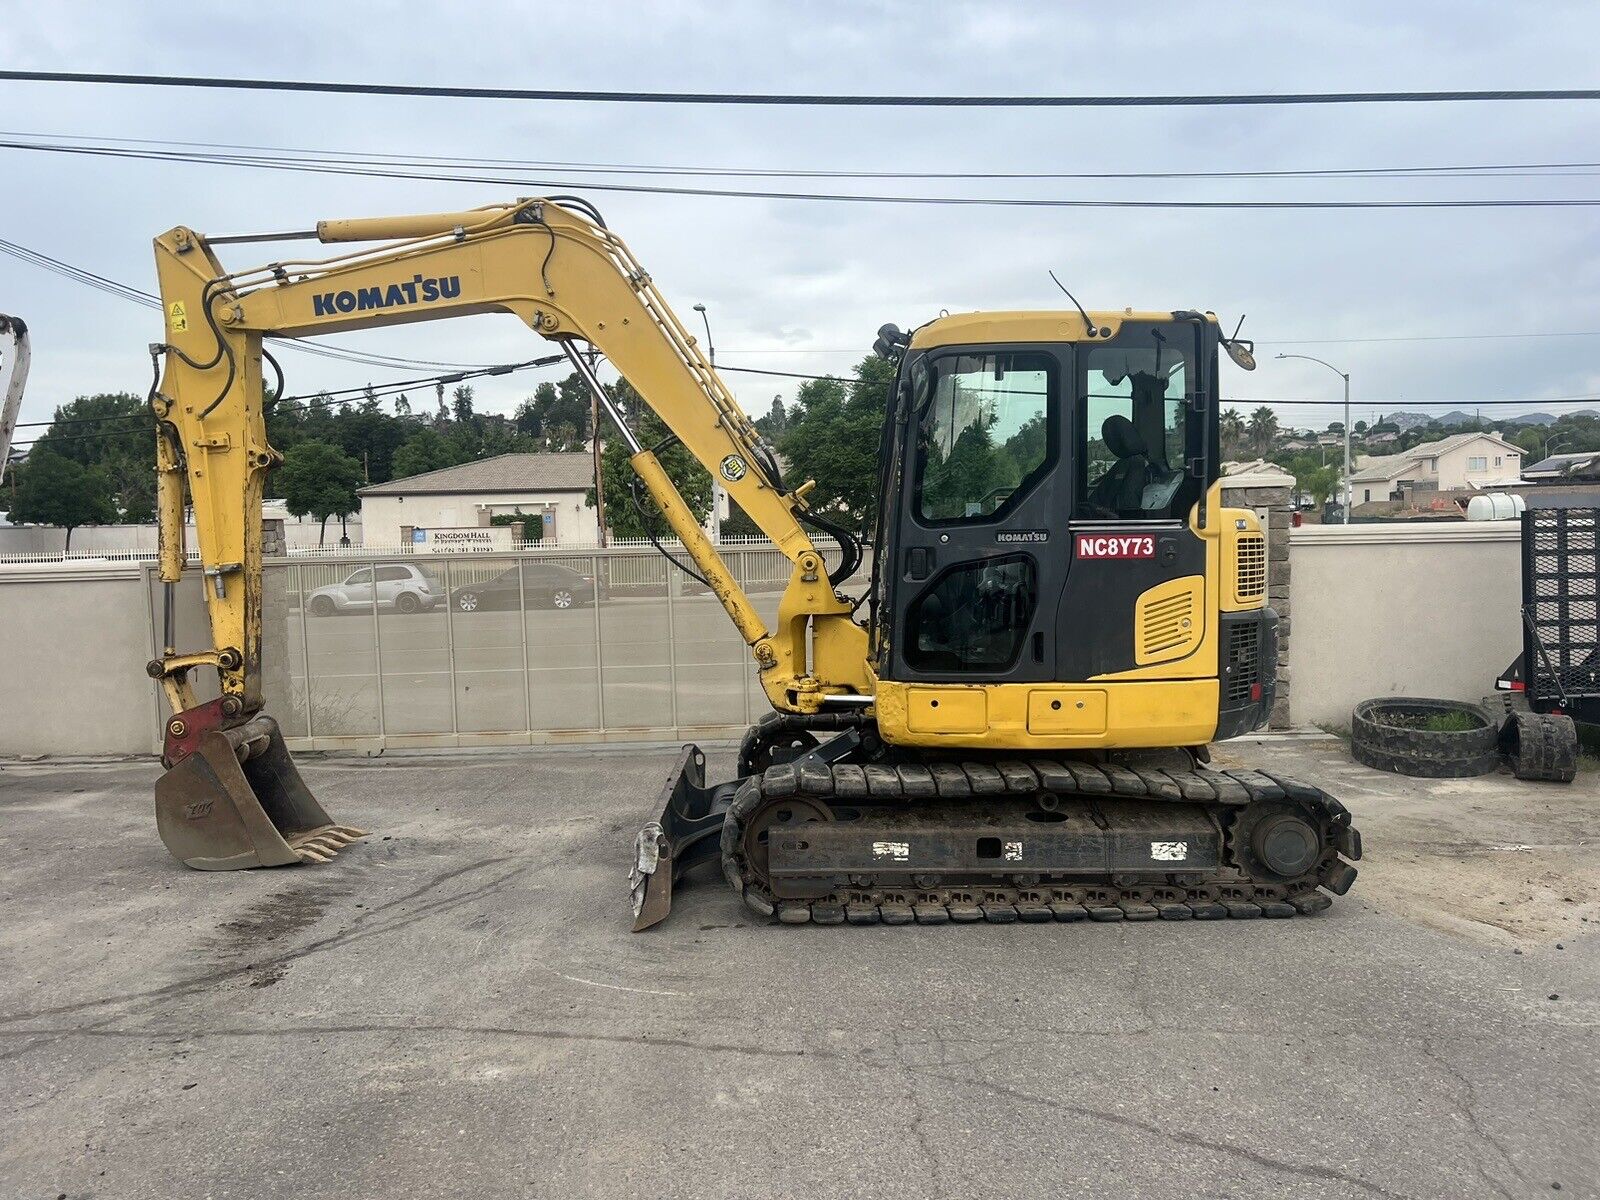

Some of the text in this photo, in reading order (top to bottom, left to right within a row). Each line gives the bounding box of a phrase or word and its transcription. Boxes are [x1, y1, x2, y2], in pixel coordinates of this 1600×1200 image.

[312, 274, 461, 316] KOMATSU
[728, 460, 741, 474] 811
[997, 532, 1047, 542] KOMATSU
[1080, 538, 1154, 556] NC8Y73
